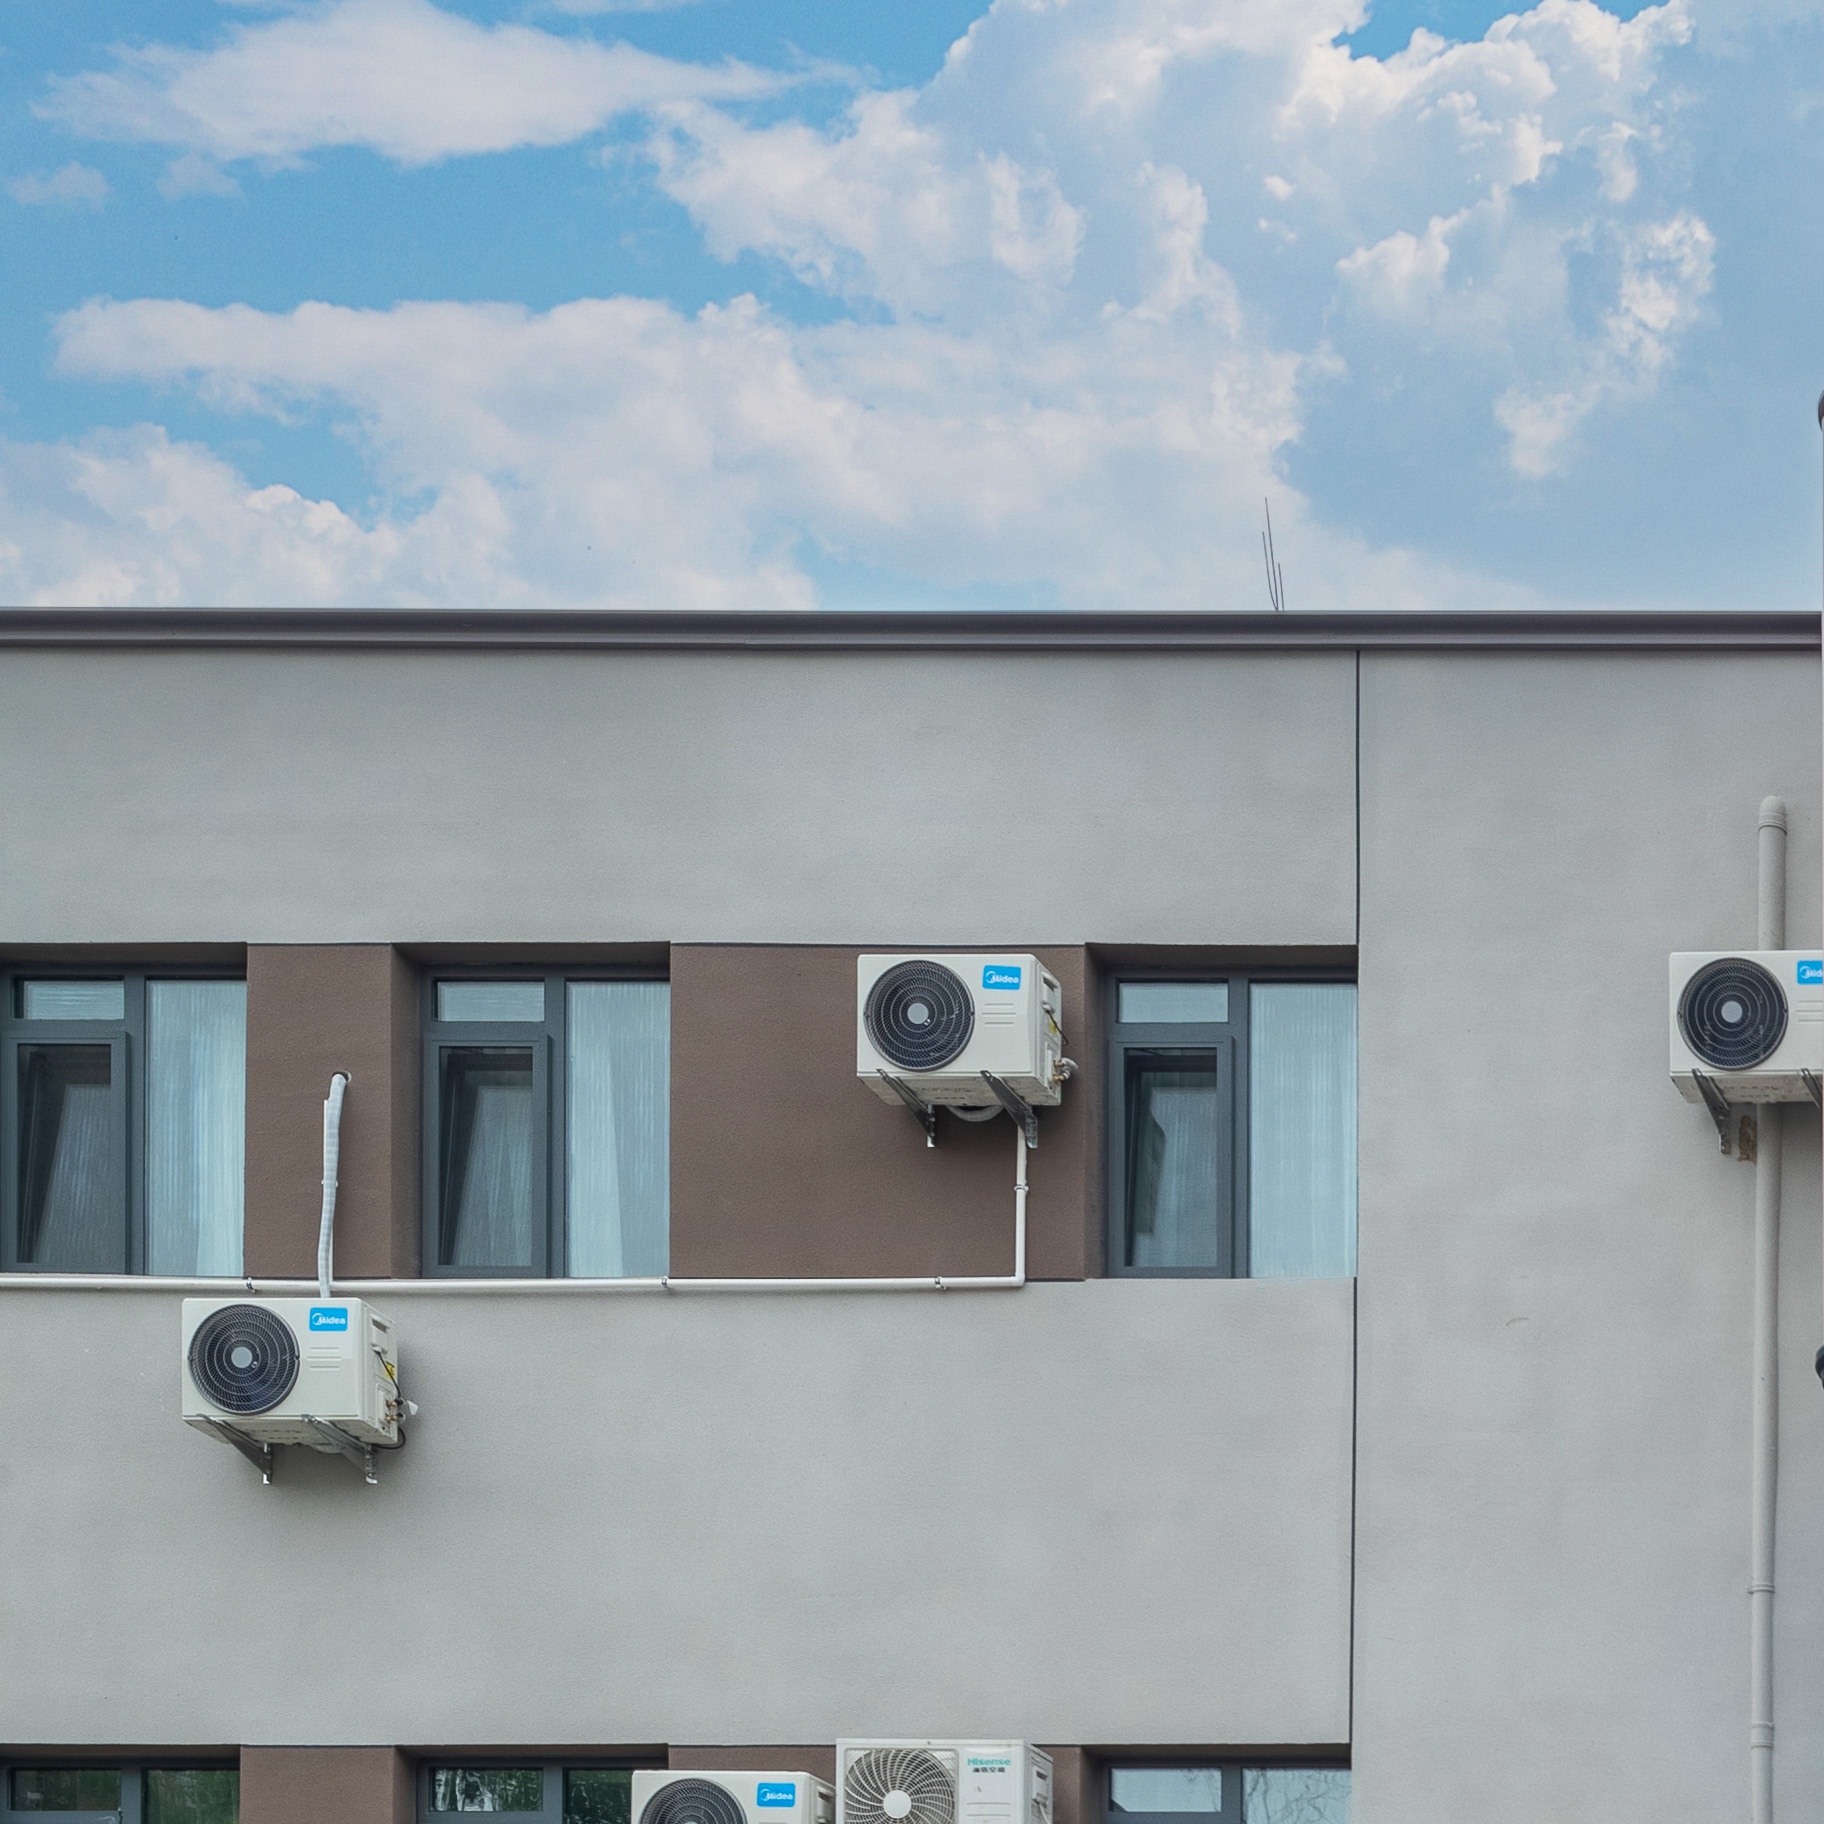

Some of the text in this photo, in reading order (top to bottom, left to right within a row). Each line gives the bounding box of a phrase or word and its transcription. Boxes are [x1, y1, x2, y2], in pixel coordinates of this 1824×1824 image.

[986, 971, 1019, 984] Midea
[312, 1313, 346, 1326] Midea
[968, 1758, 1011, 1766] Hisense
[761, 1788, 794, 1801] Midea
